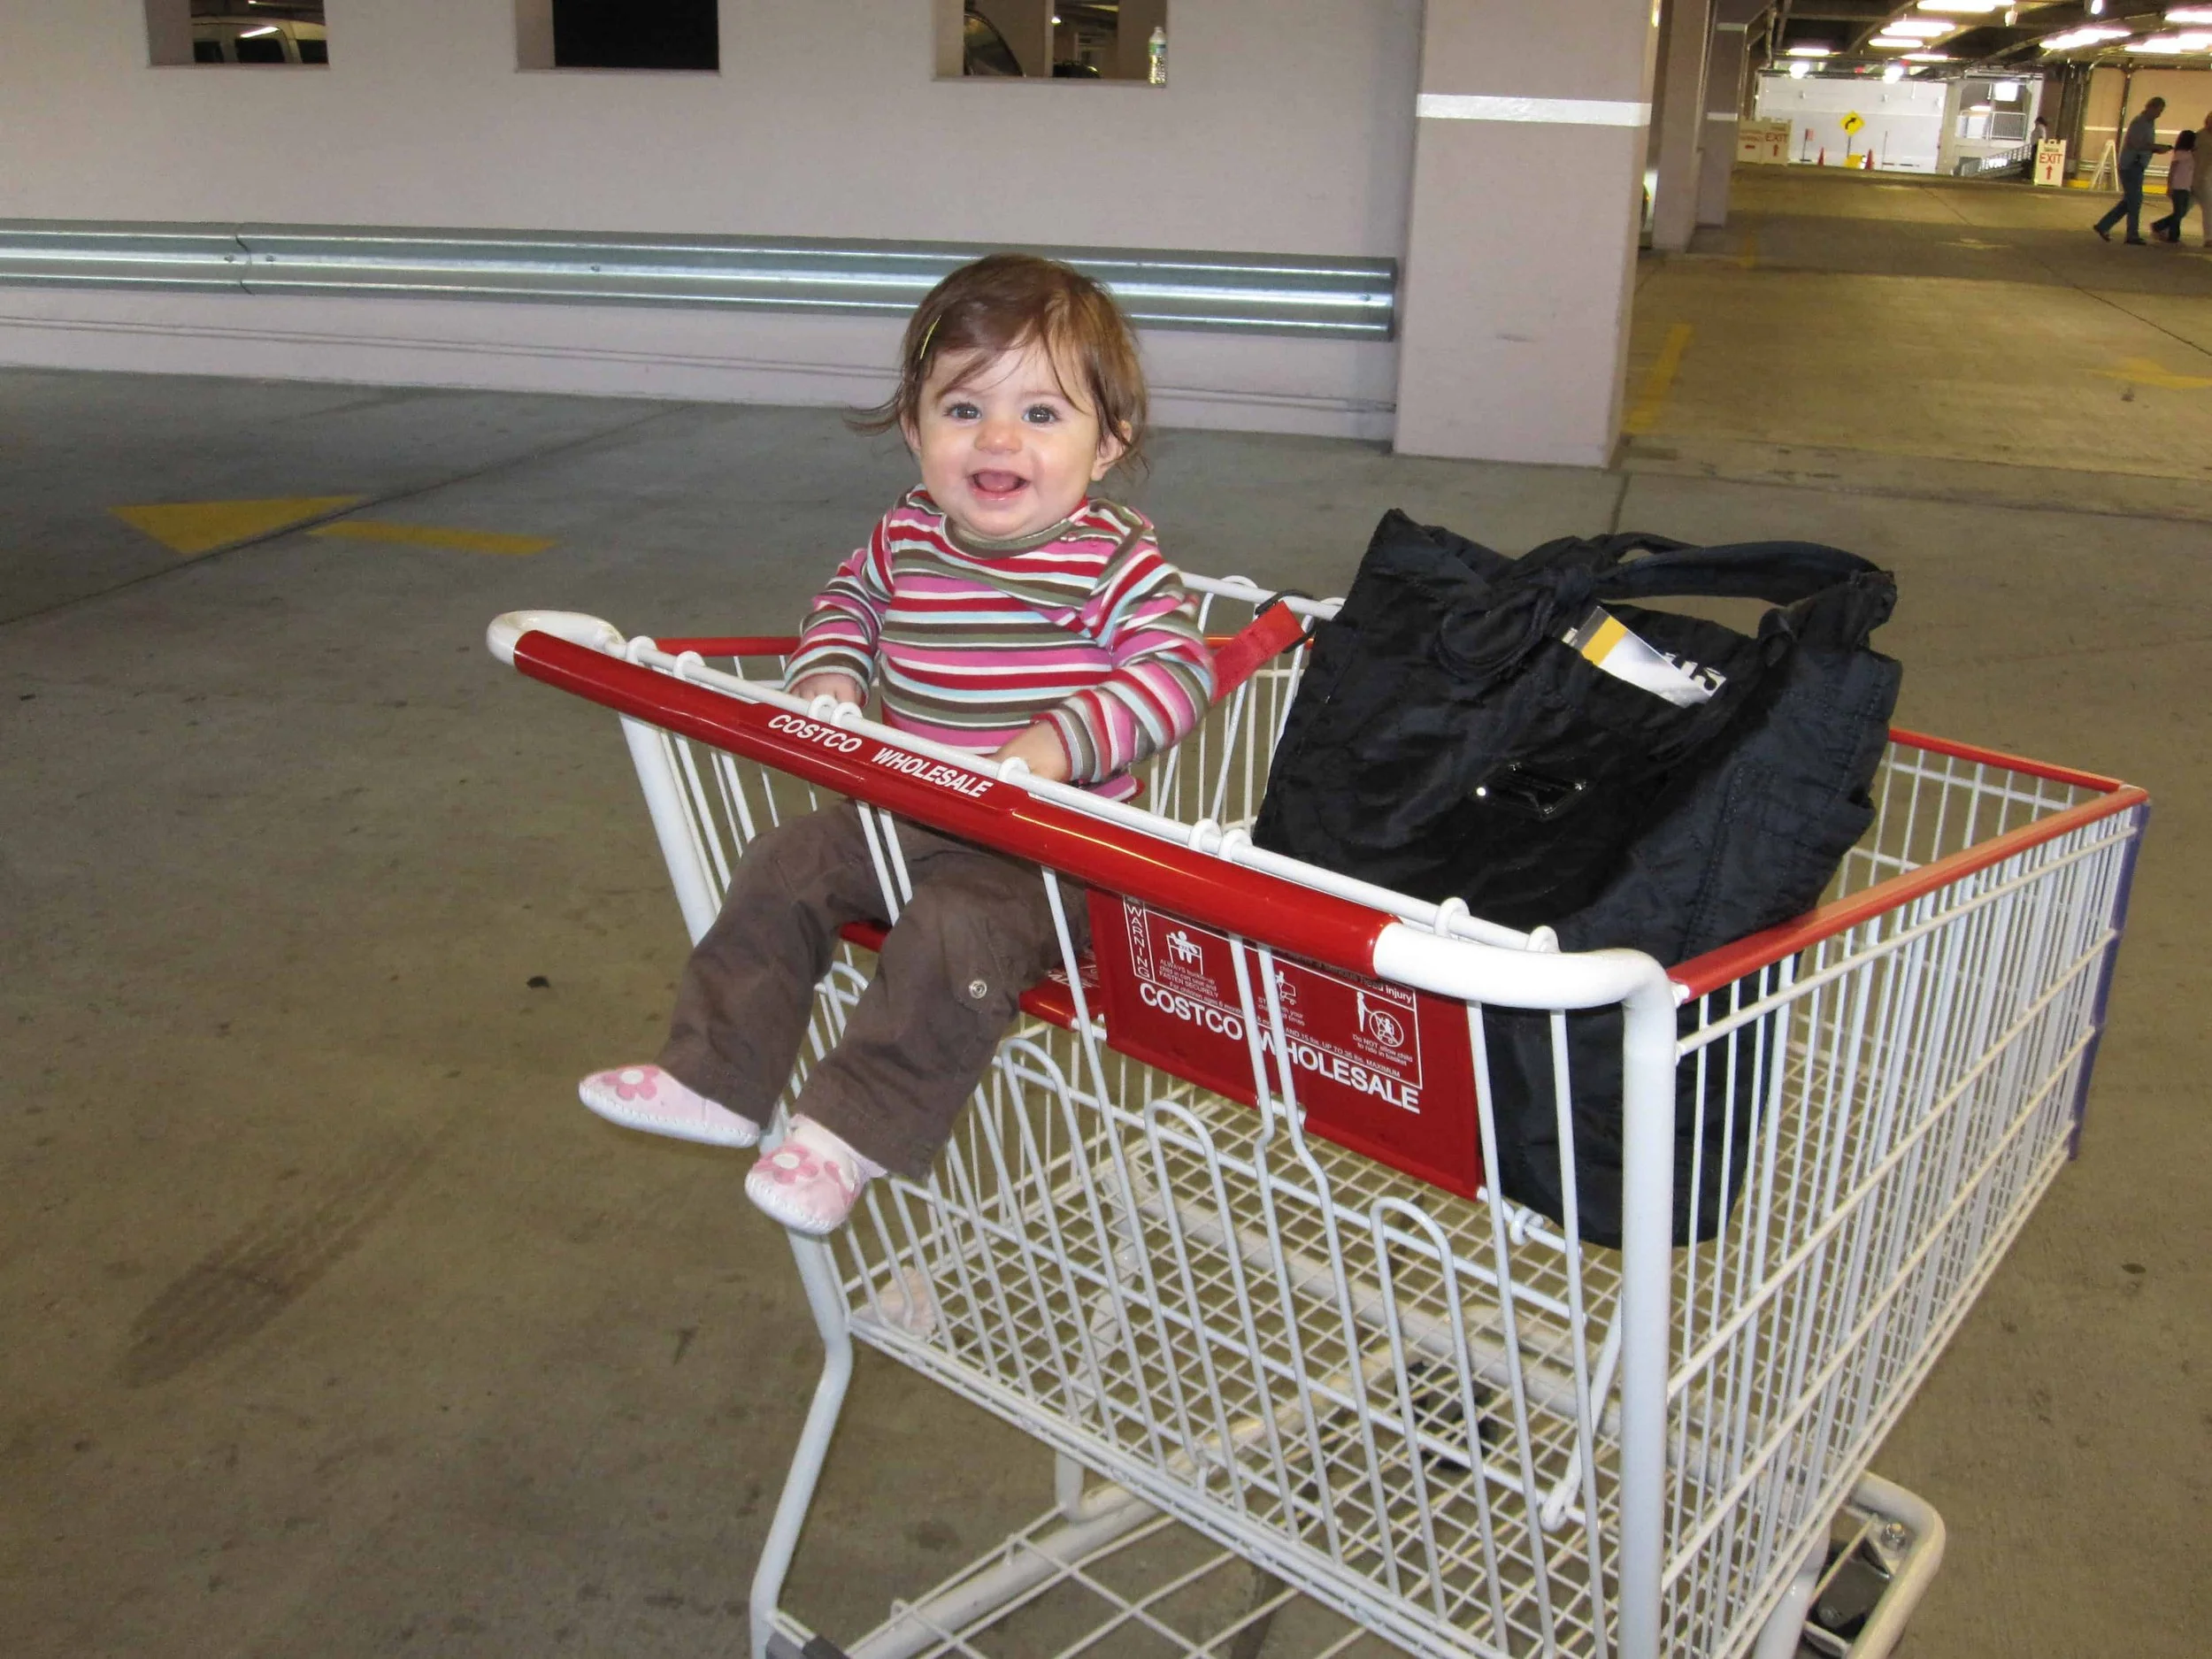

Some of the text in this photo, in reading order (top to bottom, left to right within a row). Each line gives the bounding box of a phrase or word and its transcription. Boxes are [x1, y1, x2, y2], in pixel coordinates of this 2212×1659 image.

[2039, 153, 2062, 164] EXIT
[768, 714, 994, 798] COSTCO WHOLESALE
[1126, 904, 1150, 978] WARNING
[1159, 970, 1184, 985] FASTEN
[1160, 958, 1186, 973] ALWAYS
[1140, 982, 1243, 1041] COSTCO
[1286, 1027, 1300, 1038] AND
[1323, 1041, 1333, 1051] UP
[1333, 1045, 1343, 1055] TO
